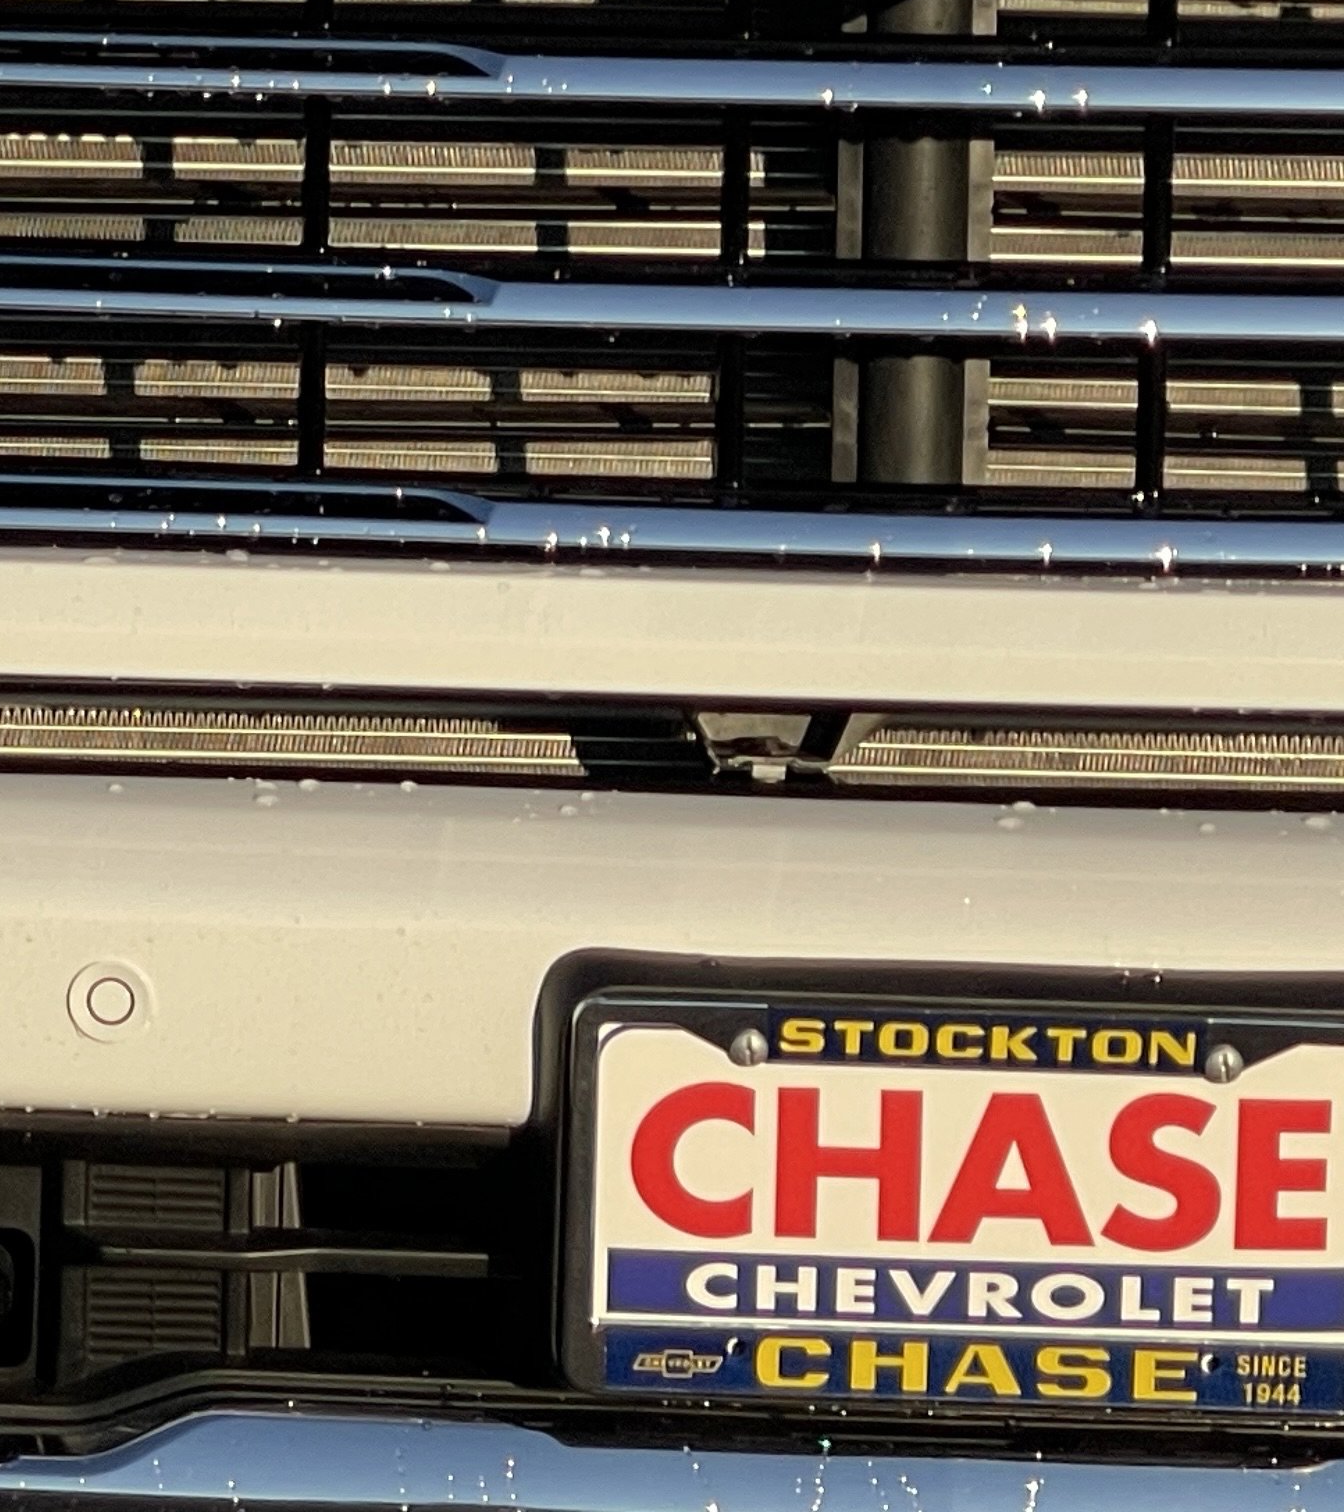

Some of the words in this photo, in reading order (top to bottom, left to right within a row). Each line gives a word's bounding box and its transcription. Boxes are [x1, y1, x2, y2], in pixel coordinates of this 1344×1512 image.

[778, 1018, 1197, 1067] STOCKTON
[629, 1081, 1333, 1253] CHASE
[684, 1262, 1276, 1326] CHEVROLET
[756, 1335, 1200, 1403] CHASE
[1236, 1354, 1307, 1378] SINCE
[1243, 1382, 1302, 1406] 1944
